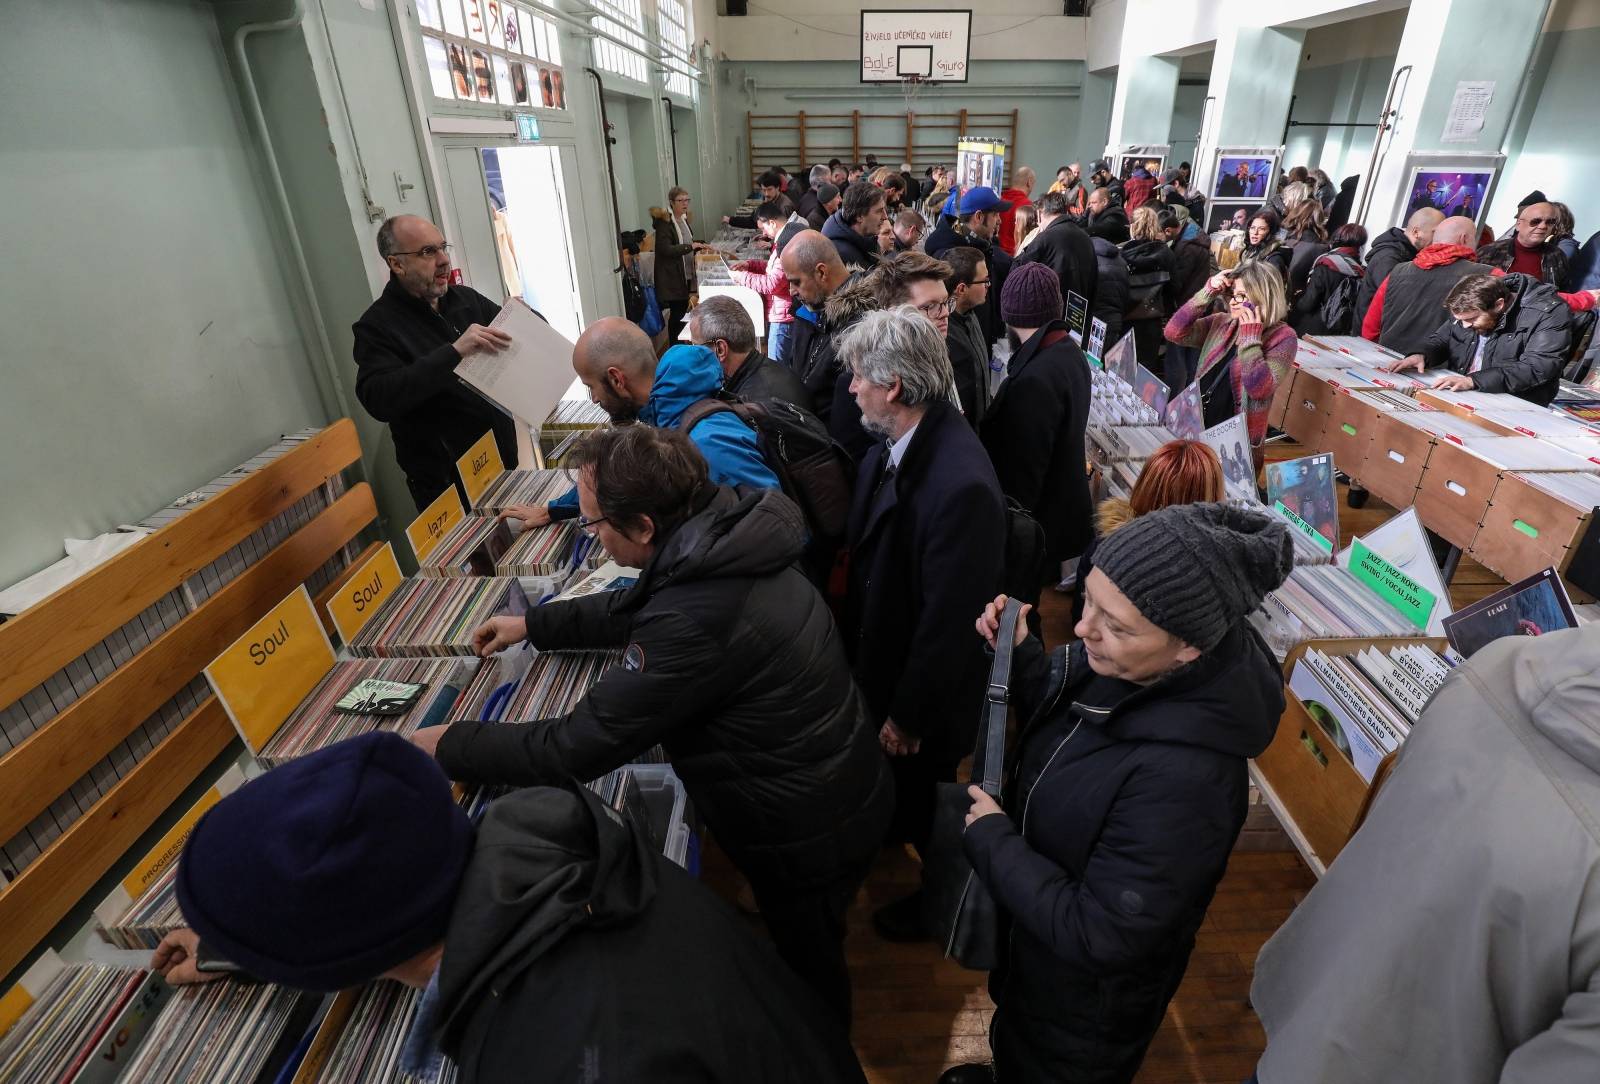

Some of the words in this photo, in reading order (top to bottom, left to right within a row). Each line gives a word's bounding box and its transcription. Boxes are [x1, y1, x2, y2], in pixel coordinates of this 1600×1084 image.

[472, 451, 489, 476] Jazz
[427, 511, 448, 540] Jazz
[352, 570, 383, 613] Soul
[1361, 560, 1380, 579] SWING
[1384, 578, 1405, 596] VOCAL
[1404, 593, 1422, 609] JAZZ
[1366, 552, 1382, 566] JAZZ
[1384, 565, 1420, 593] JAZZ-ROCK
[249, 619, 290, 667] Soul
[1392, 669, 1422, 700] BEATLES
[1399, 656, 1421, 680] BYRDS
[1313, 658, 1336, 682] ALLMAN
[1335, 683, 1367, 719] BROTHERS
[1366, 716, 1385, 740] BAND
[1382, 675, 1395, 691] THE
[1394, 687, 1420, 717] BEATLE
[142, 826, 193, 884] PROGRESSIV
